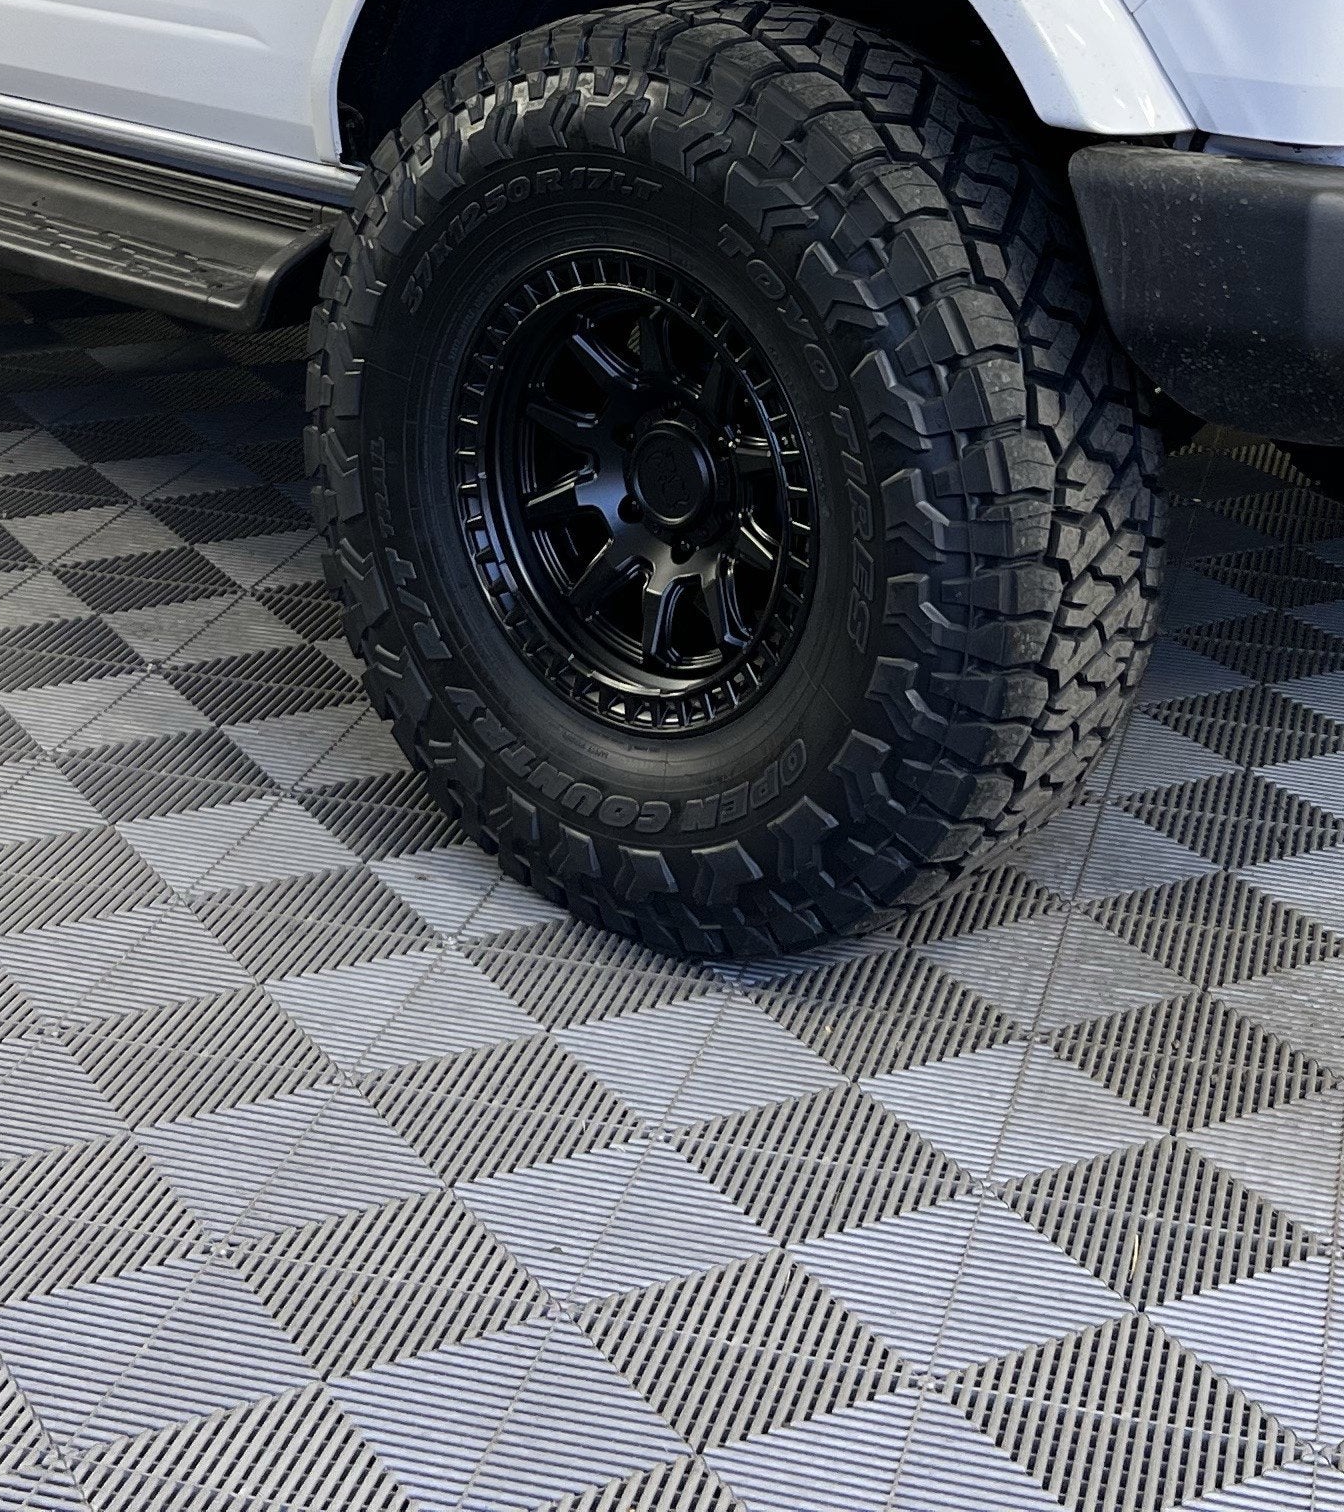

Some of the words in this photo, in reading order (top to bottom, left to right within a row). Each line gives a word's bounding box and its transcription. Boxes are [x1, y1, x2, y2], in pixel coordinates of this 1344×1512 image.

[718, 222, 840, 392] TOYO
[829, 404, 875, 654] TIRES
[384, 546, 453, 660] R/T
[445, 686, 672, 834] COUNTRY
[680, 737, 807, 833] OPEN
